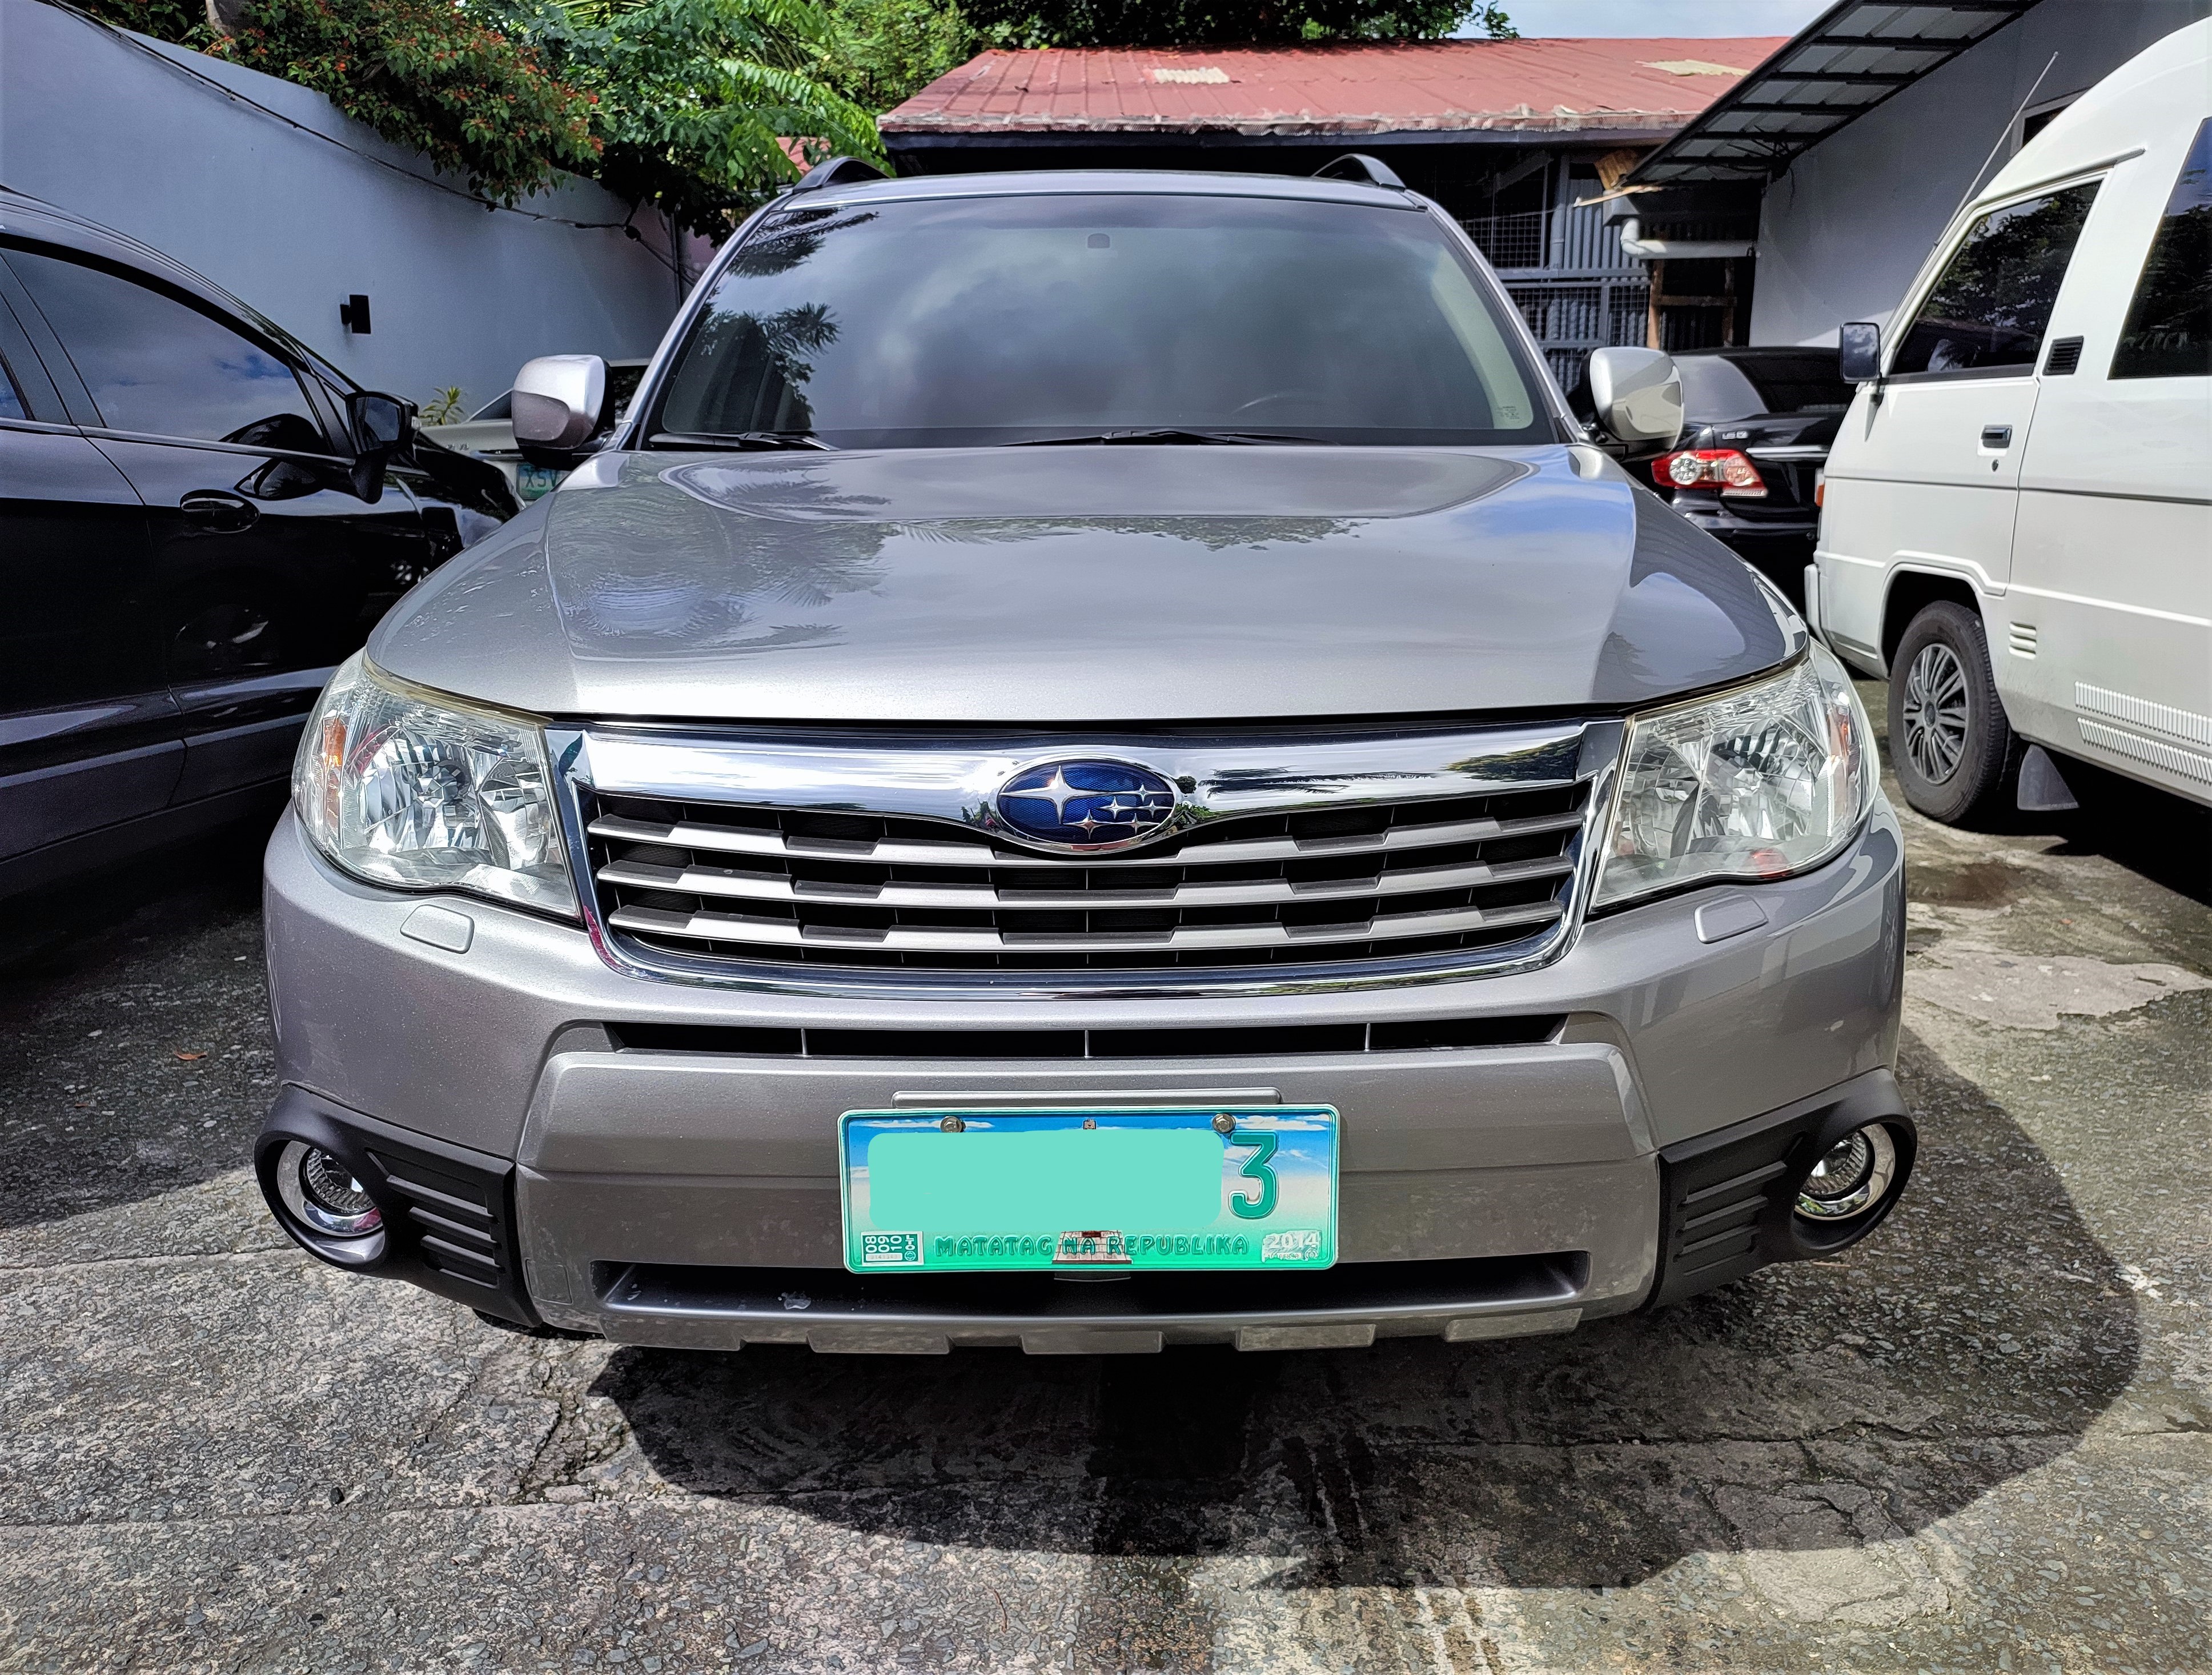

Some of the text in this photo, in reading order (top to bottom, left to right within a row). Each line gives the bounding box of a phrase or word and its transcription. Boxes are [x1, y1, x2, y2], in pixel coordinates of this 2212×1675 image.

[1228, 1131, 1279, 1219] 3
[865, 1236, 877, 1253] 08
[877, 1236, 890, 1253] 09
[890, 1235, 902, 1251] 10
[934, 1235, 1250, 1257] MATATAG NA REPUBLIKA
[1267, 1233, 1319, 1249] 2014
